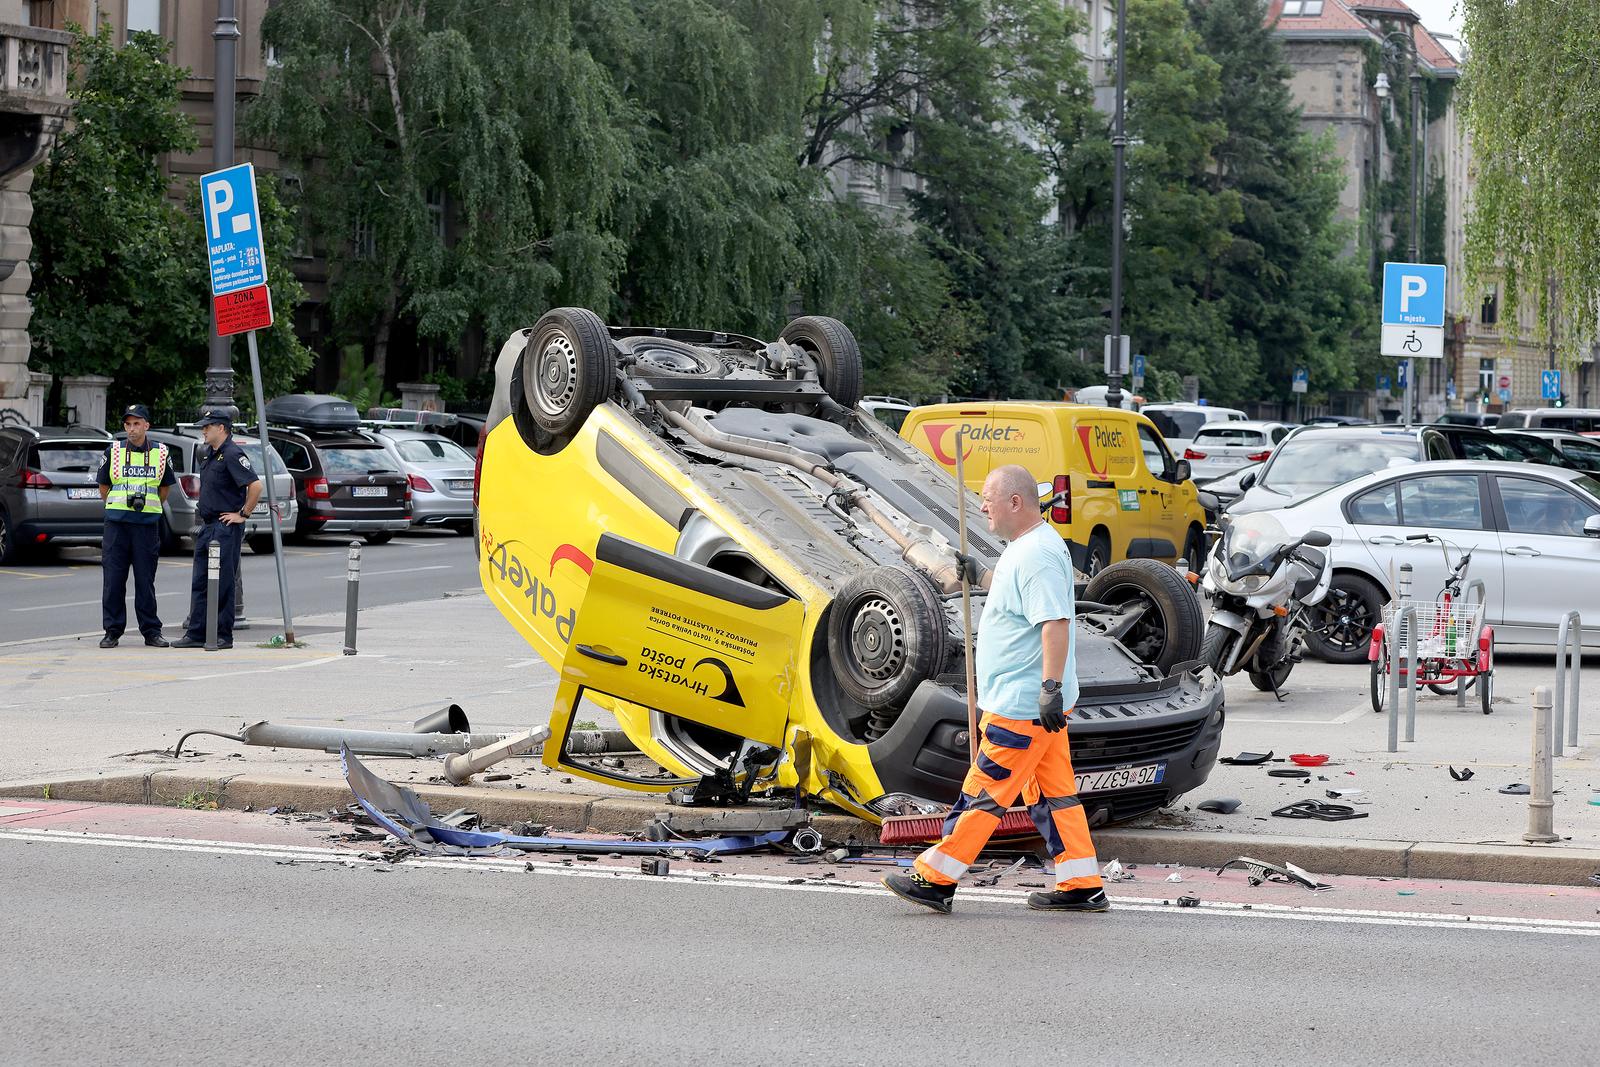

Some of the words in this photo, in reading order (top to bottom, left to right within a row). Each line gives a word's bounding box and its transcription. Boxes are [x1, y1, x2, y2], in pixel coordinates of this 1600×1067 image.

[207, 180, 234, 239] P
[211, 242, 235, 255] NAPLATA:
[234, 290, 254, 304] ZONA
[1400, 275, 1427, 313] P
[1404, 314, 1426, 324] mjesto
[1398, 366, 1404, 383] P
[961, 424, 1019, 440] Paket
[1094, 425, 1122, 448] Paket
[978, 445, 1024, 454] Povezujemo
[488, 542, 576, 644] Paket
[651, 606, 681, 620] POTREBE
[649, 616, 670, 628] Gorica
[672, 624, 692, 636] Velika
[682, 618, 714, 632] VLASTITE
[692, 632, 712, 642] 10410
[726, 632, 758, 648] PRIJEVOZ
[720, 640, 756, 656] Poštanska
[641, 646, 686, 670] pošta
[638, 662, 708, 696] Hrvatska
[1138, 766, 1156, 784] ZG
